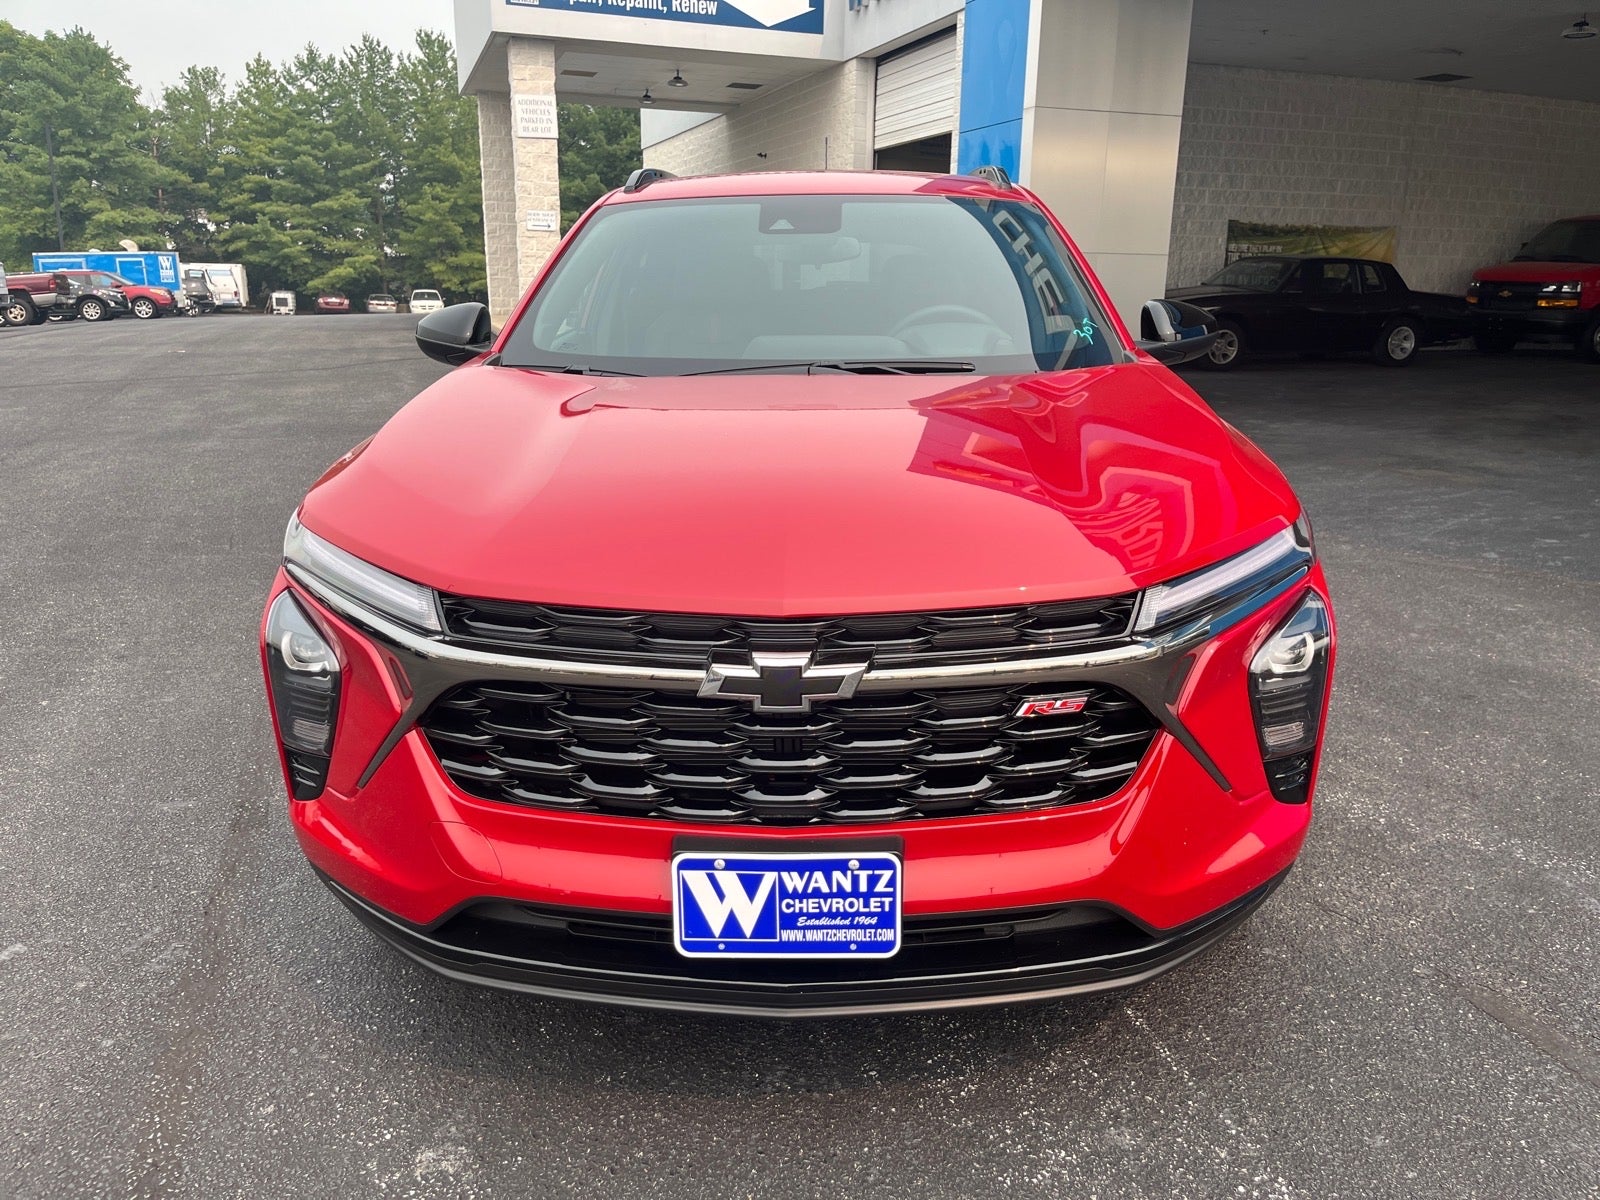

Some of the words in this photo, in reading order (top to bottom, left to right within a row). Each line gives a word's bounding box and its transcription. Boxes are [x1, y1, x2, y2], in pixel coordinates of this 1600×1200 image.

[672, 0, 718, 15] Renew
[517, 98, 553, 107] ADDITIONAL
[521, 108, 551, 116] VEHICLES
[1015, 697, 1088, 717] RS
[780, 870, 894, 894] WANTZ
[681, 871, 778, 939] W
[781, 897, 893, 913] CHEVROLET
[797, 916, 852, 926] Established
[853, 915, 878, 925] 1964
[781, 928, 894, 942] WWW.WANTZCHEVROLET.COM
